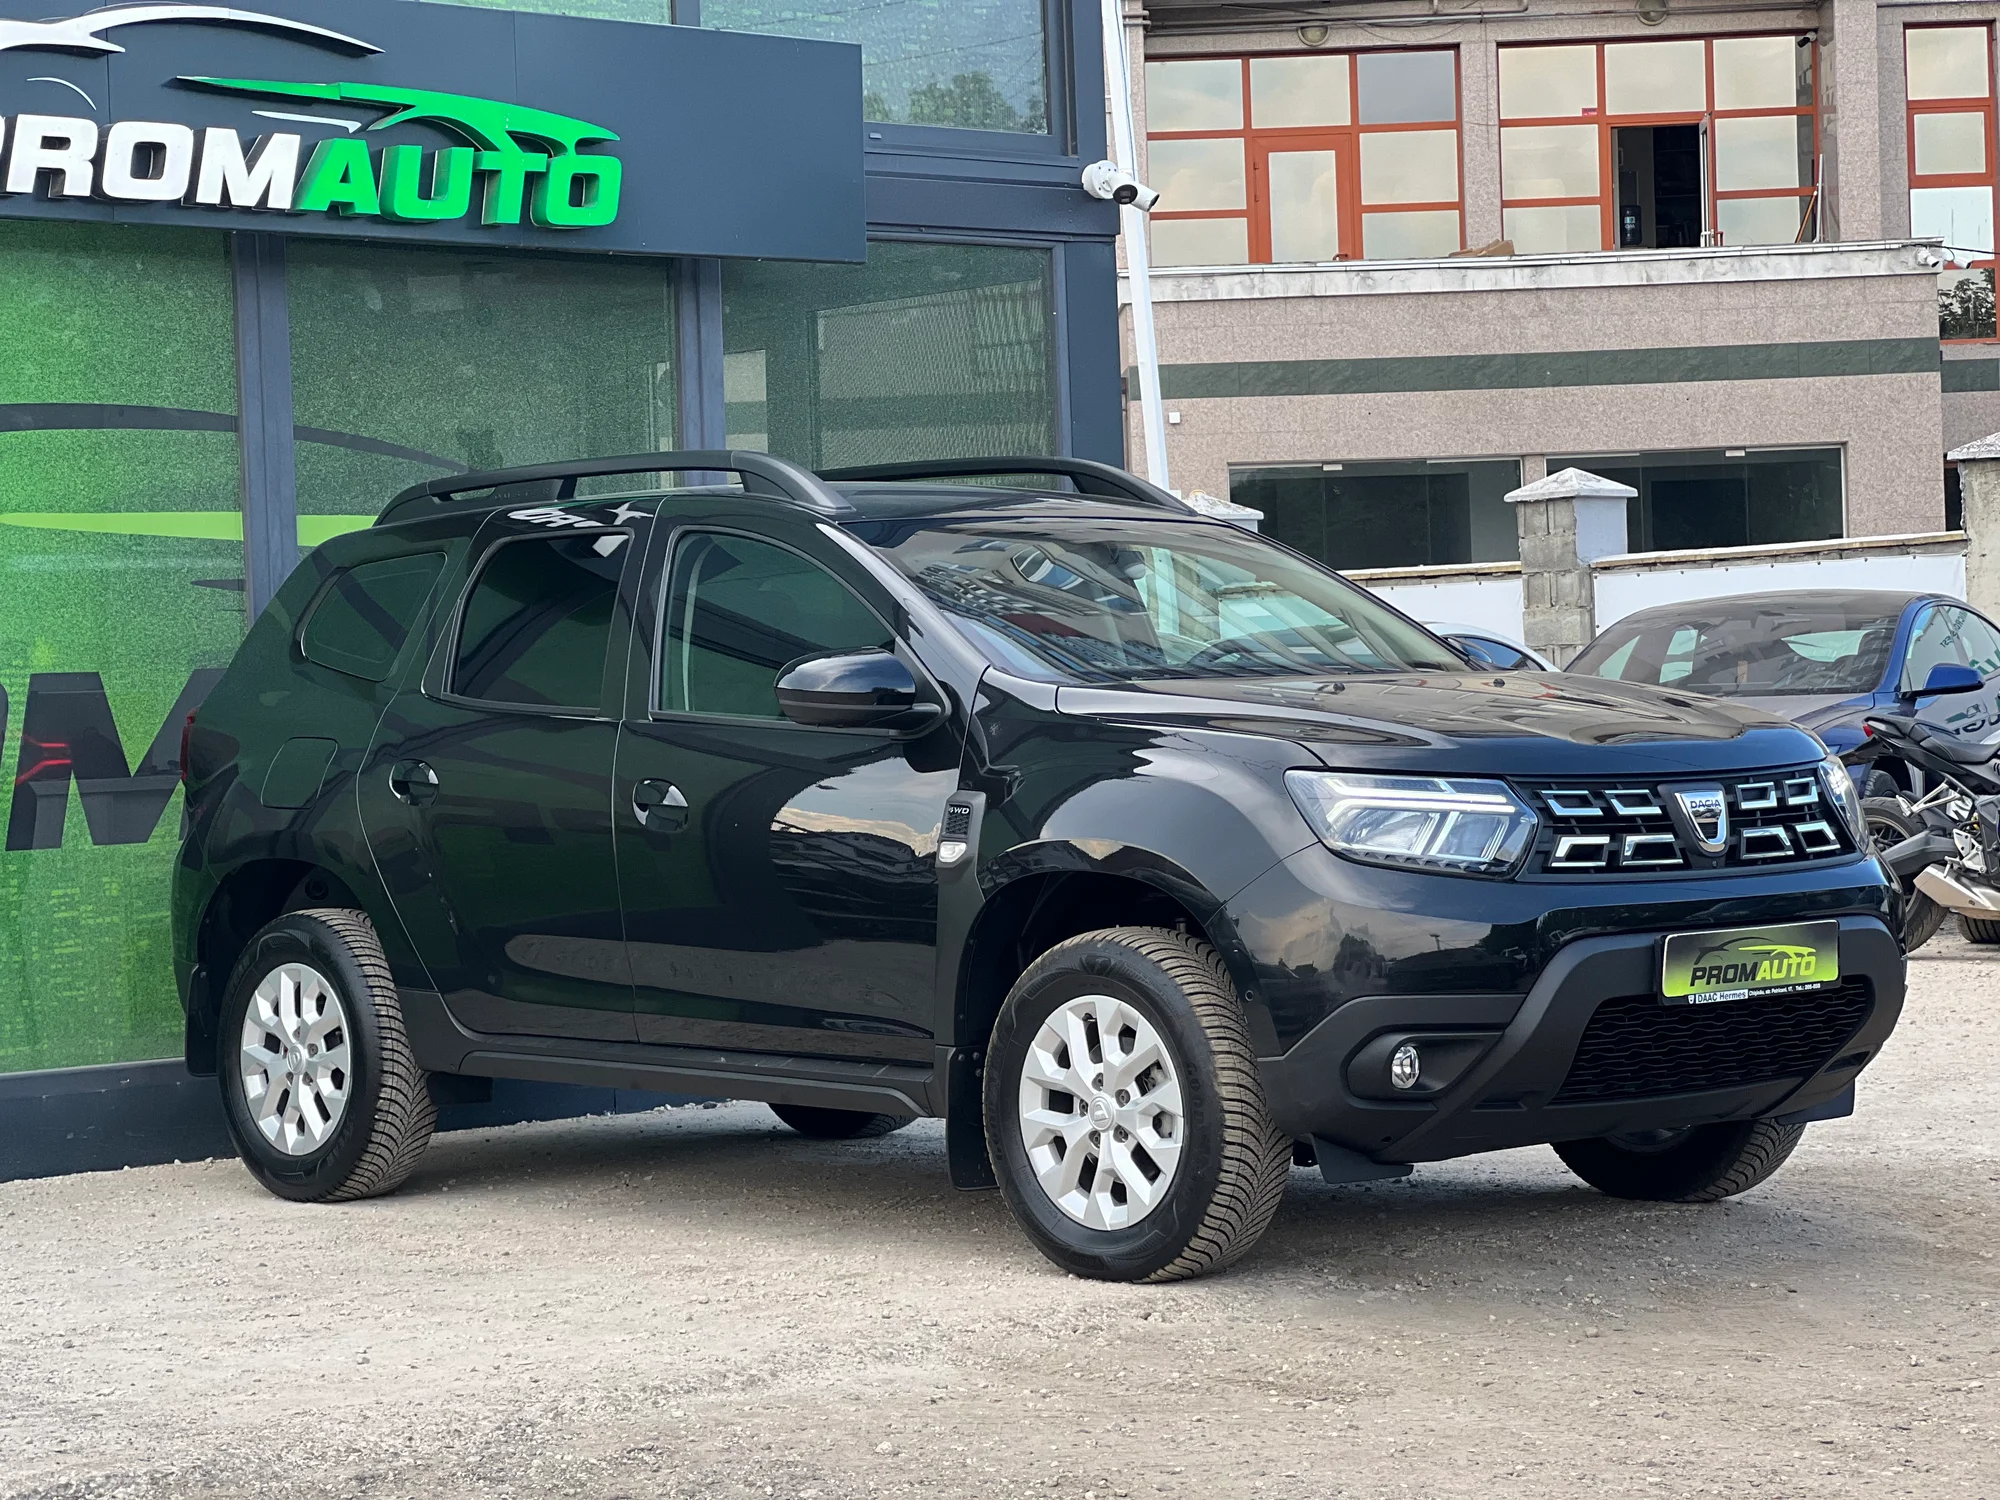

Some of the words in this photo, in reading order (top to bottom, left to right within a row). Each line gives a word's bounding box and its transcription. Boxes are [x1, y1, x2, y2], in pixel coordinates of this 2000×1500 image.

[0, 112, 622, 227] ROMAUTO
[948, 806, 970, 814] 4WD
[1690, 799, 1721, 809] DACIA
[1689, 955, 1817, 987] PROMAUTO
[1697, 993, 1718, 1003] DAAC
[1719, 991, 1746, 1001] Hermes
